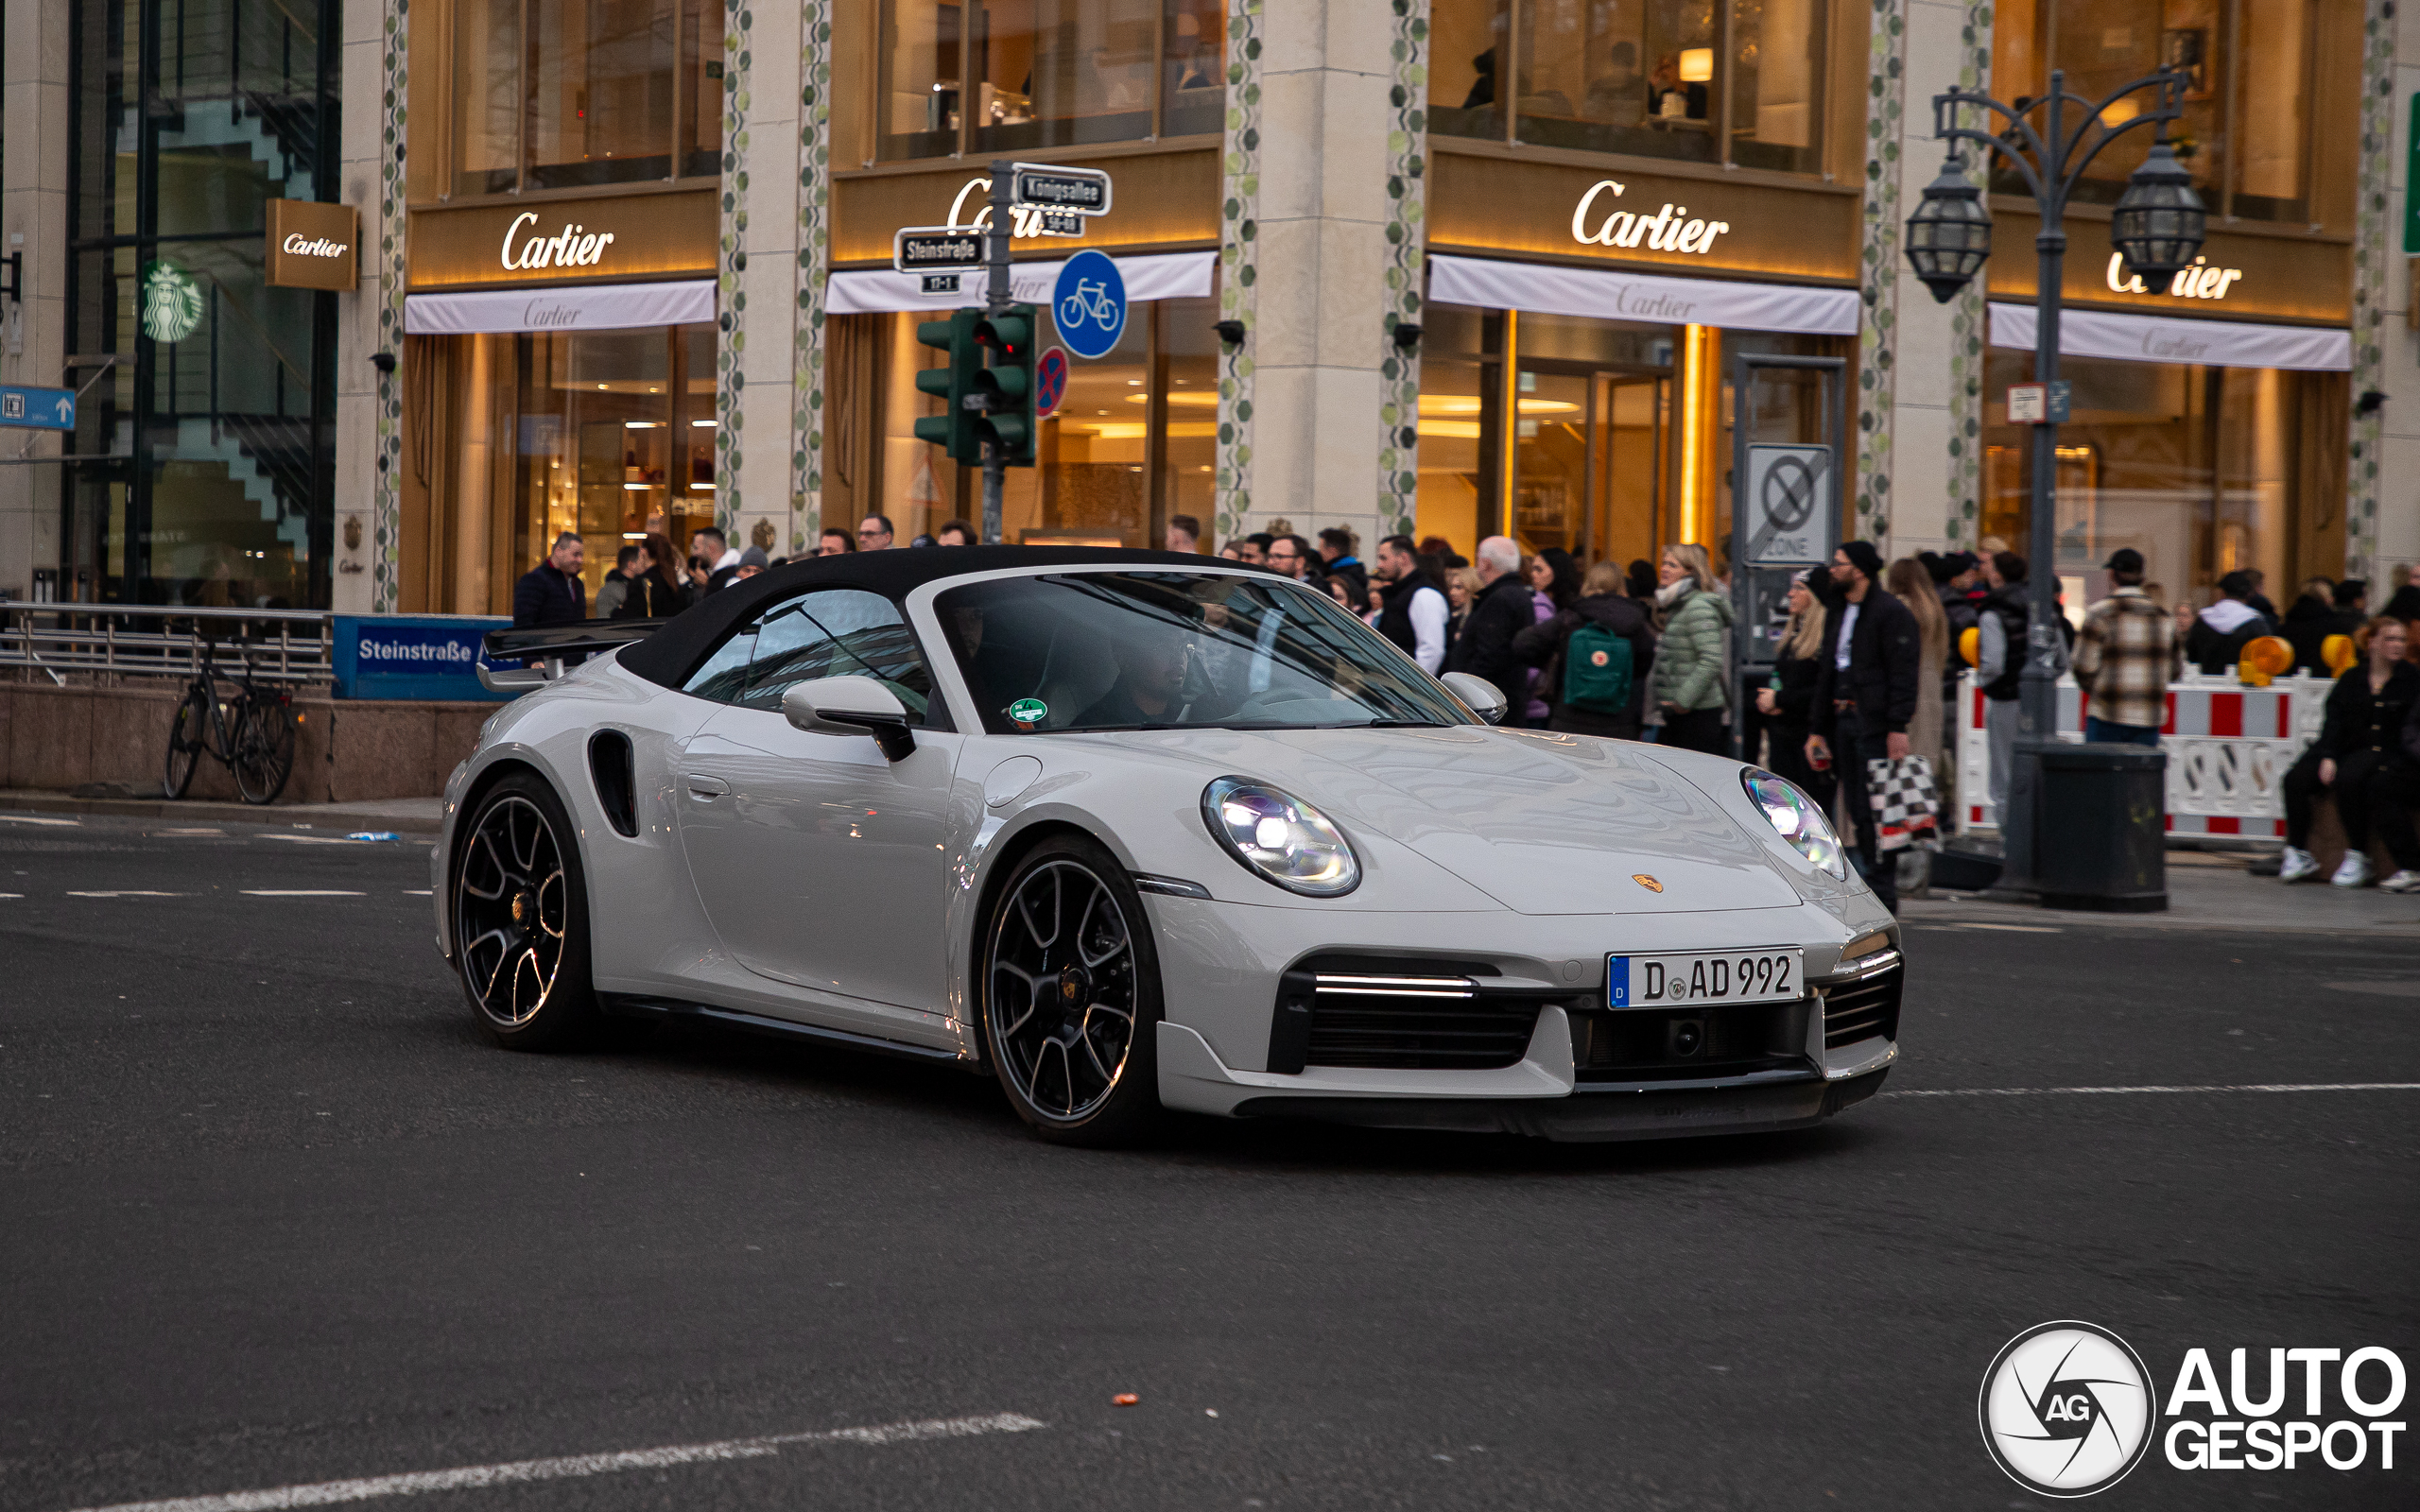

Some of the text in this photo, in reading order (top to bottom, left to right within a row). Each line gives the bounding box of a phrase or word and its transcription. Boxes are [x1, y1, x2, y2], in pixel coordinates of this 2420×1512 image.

[1027, 177, 1098, 201] Königsallee
[1571, 179, 1730, 254] Cartier
[283, 232, 348, 257] Cartier
[500, 211, 614, 270] Cartier
[907, 238, 976, 261] Steinstraße
[523, 297, 581, 327] Cartier
[1616, 282, 1697, 317] Cartier
[1765, 536, 1807, 557] ZONE
[358, 638, 472, 662] Steinstraße
[1644, 954, 1791, 1000] D AD 992
[1615, 987, 1623, 999] D
